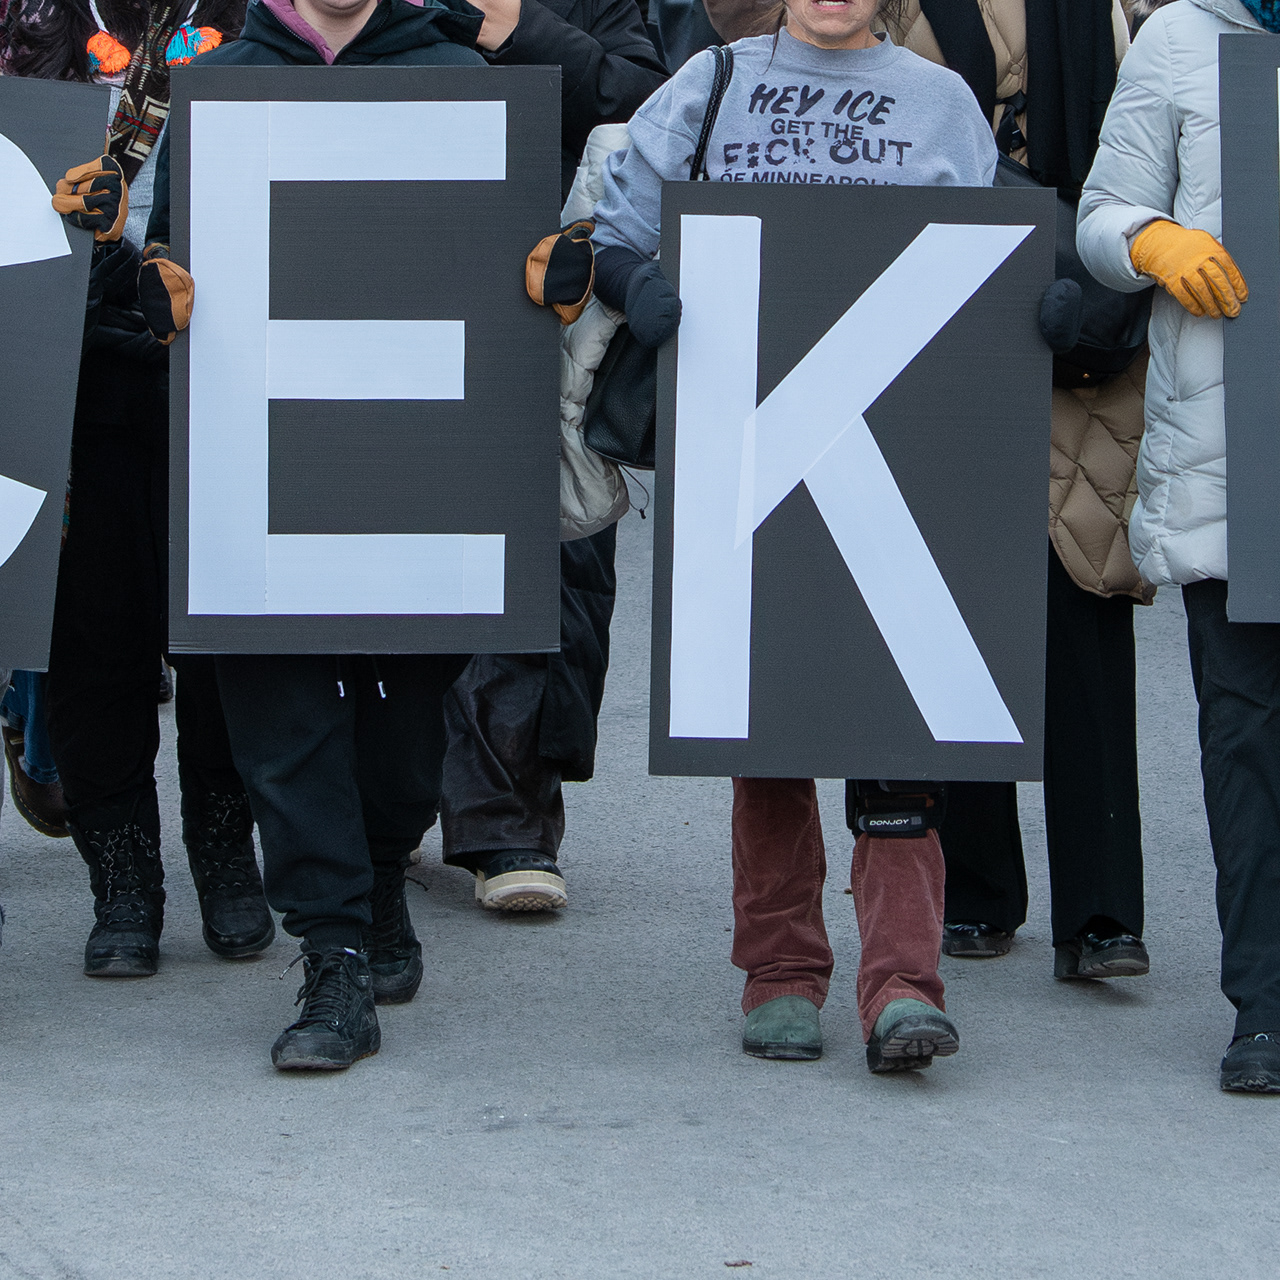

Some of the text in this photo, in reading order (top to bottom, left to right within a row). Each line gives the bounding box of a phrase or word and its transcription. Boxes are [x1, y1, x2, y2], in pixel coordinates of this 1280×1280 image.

[748, 83, 897, 126] HEY ICE
[770, 118, 865, 141] GET THE
[829, 137, 913, 168] OUT
[721, 170, 900, 187] OF MINNEAPOL
[869, 818, 910, 826] DONJOY
